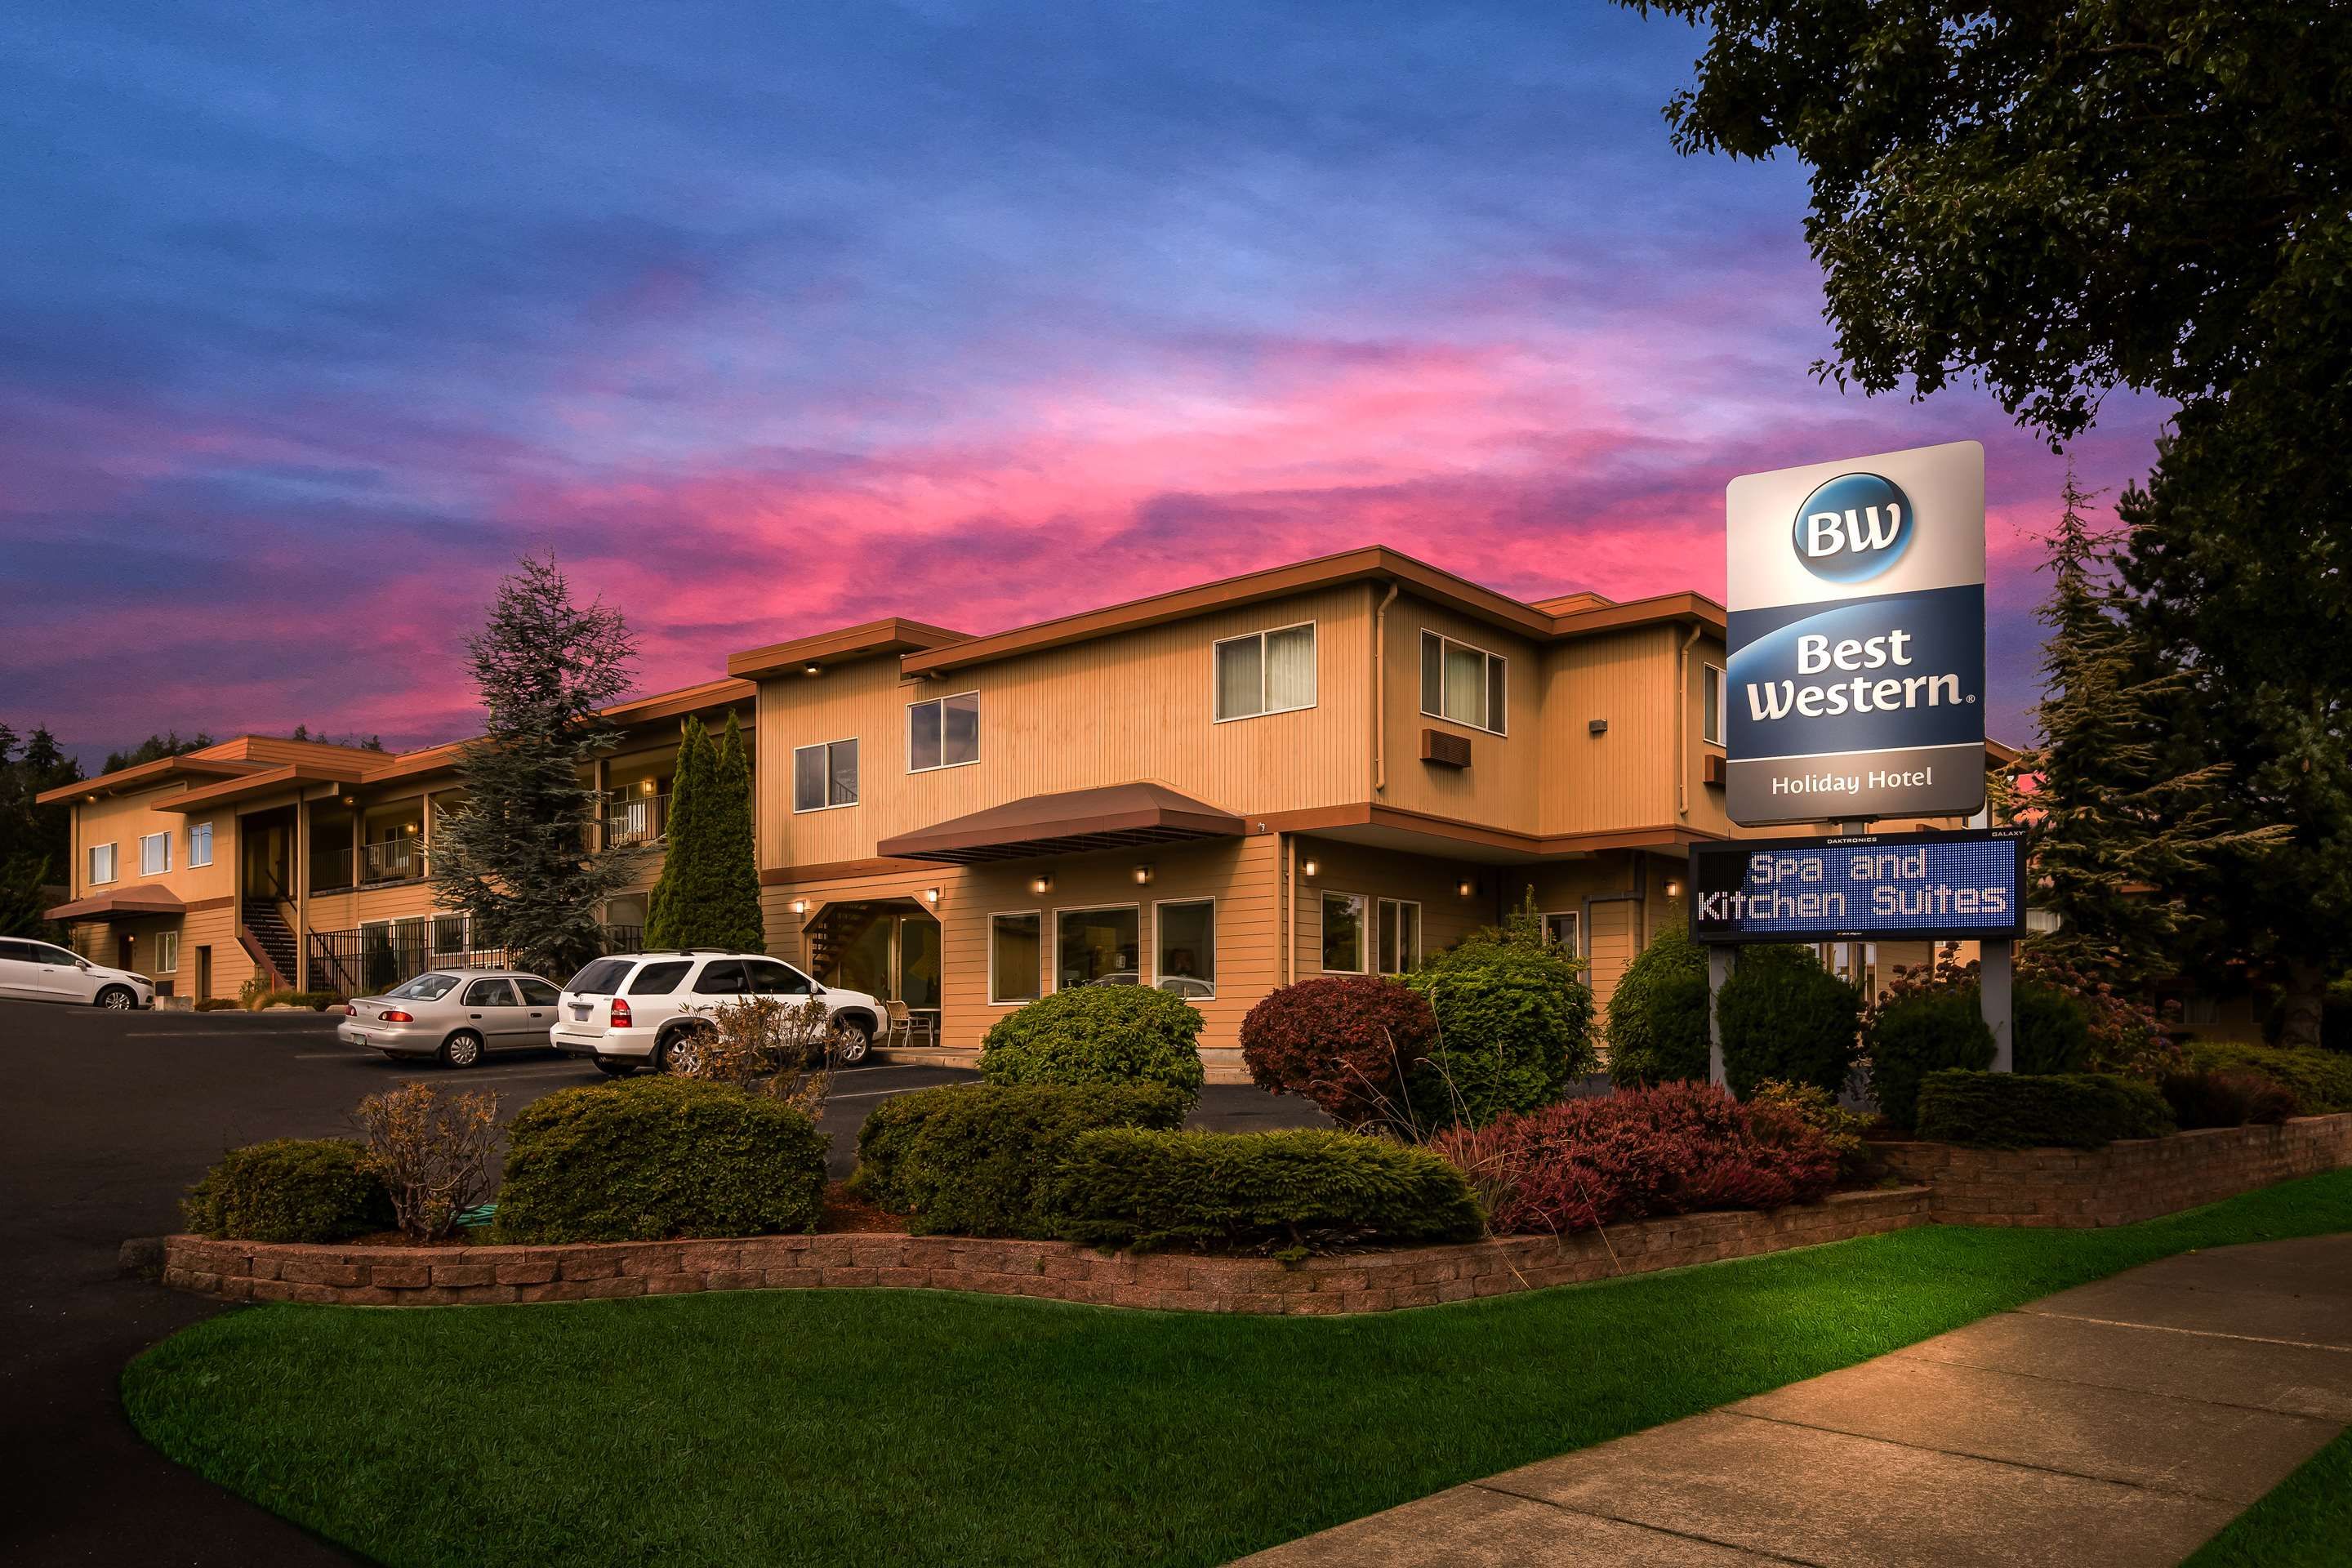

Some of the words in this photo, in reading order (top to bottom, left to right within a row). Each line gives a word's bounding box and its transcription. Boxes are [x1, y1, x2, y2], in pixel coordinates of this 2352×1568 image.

[1807, 502, 1901, 557] BW
[1797, 629, 1913, 675] Best
[1746, 673, 1963, 721] Western
[1772, 773, 1860, 795] Holiday
[1869, 766, 1932, 789] Hotel
[1751, 853, 1824, 884] Spa
[1850, 849, 1927, 881] and
[1698, 888, 1846, 921] Kitchen
[1872, 884, 2007, 916] Suites
